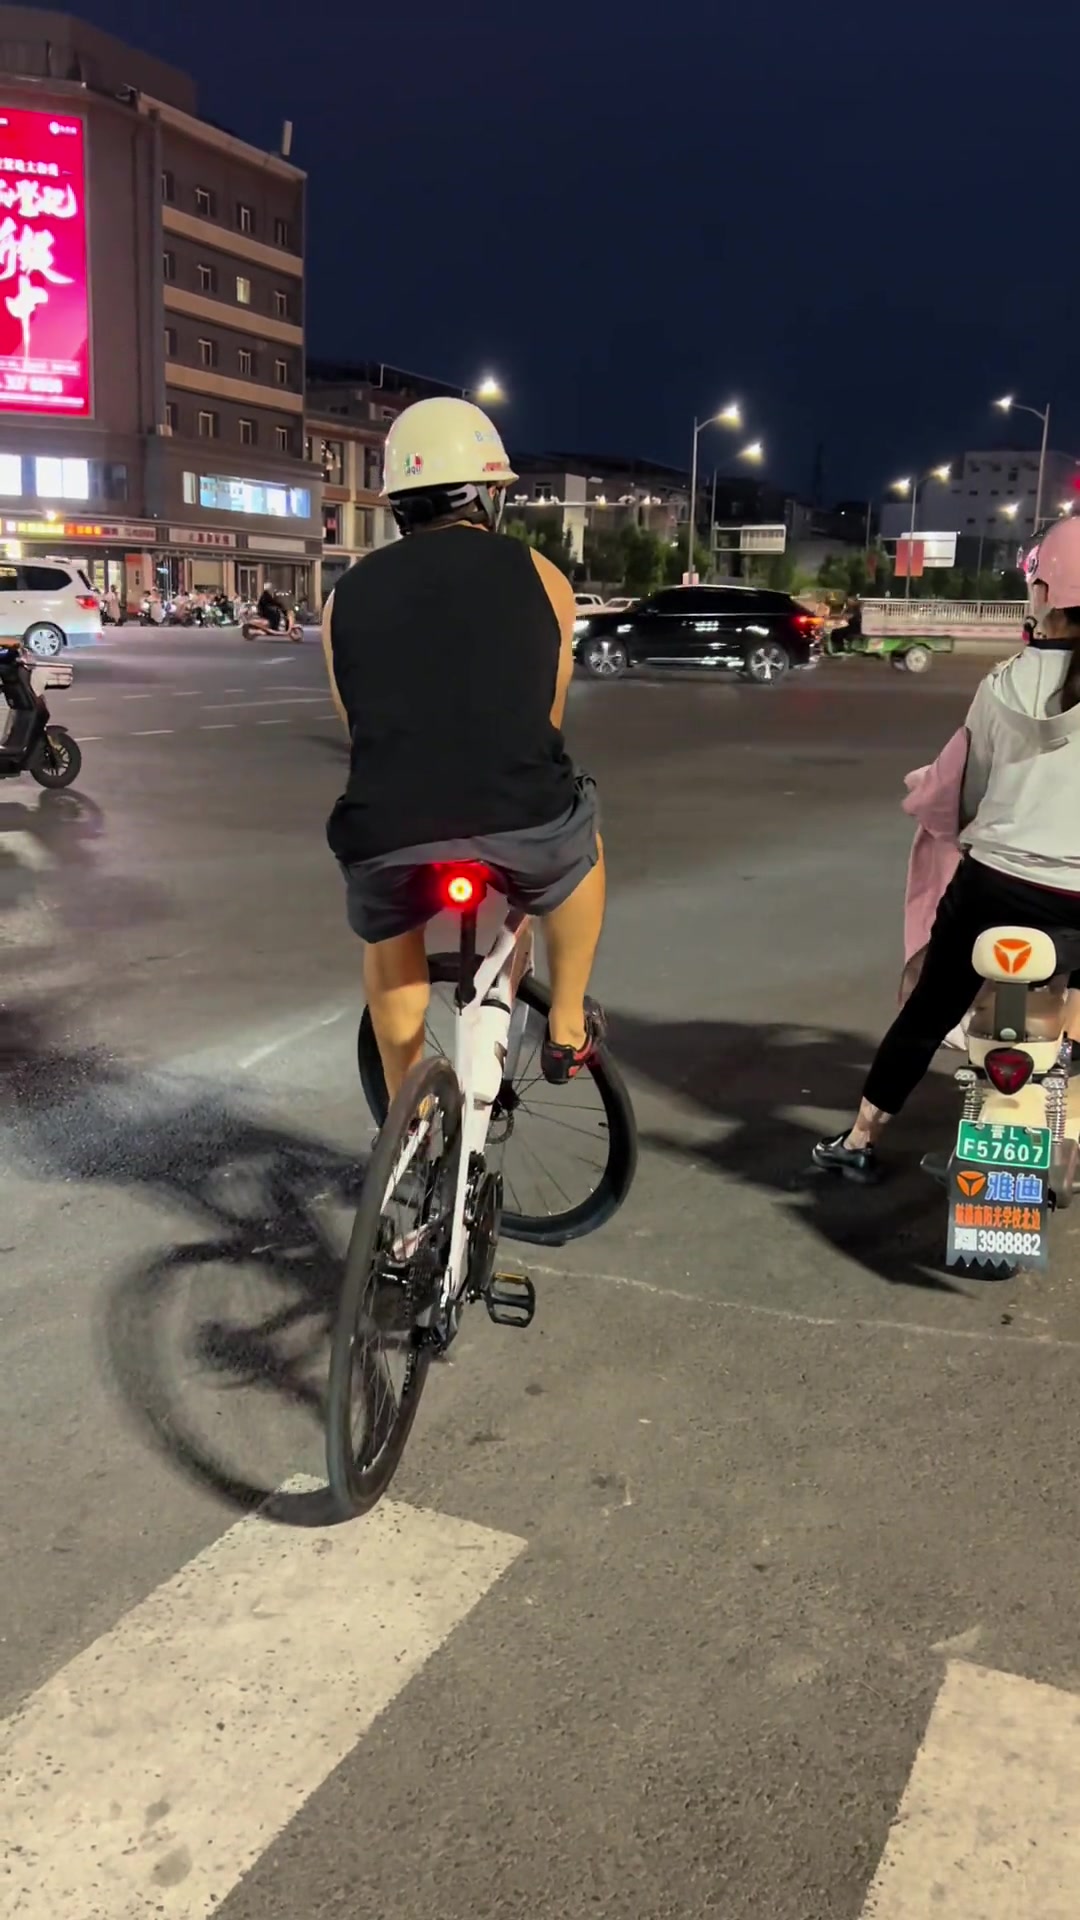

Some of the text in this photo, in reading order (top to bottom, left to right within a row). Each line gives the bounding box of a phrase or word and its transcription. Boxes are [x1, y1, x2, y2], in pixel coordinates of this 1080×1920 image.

[963, 1138, 1043, 1163] F57607
[985, 1171, 1043, 1203] 雅迪
[978, 1229, 1041, 1256] 3988882
